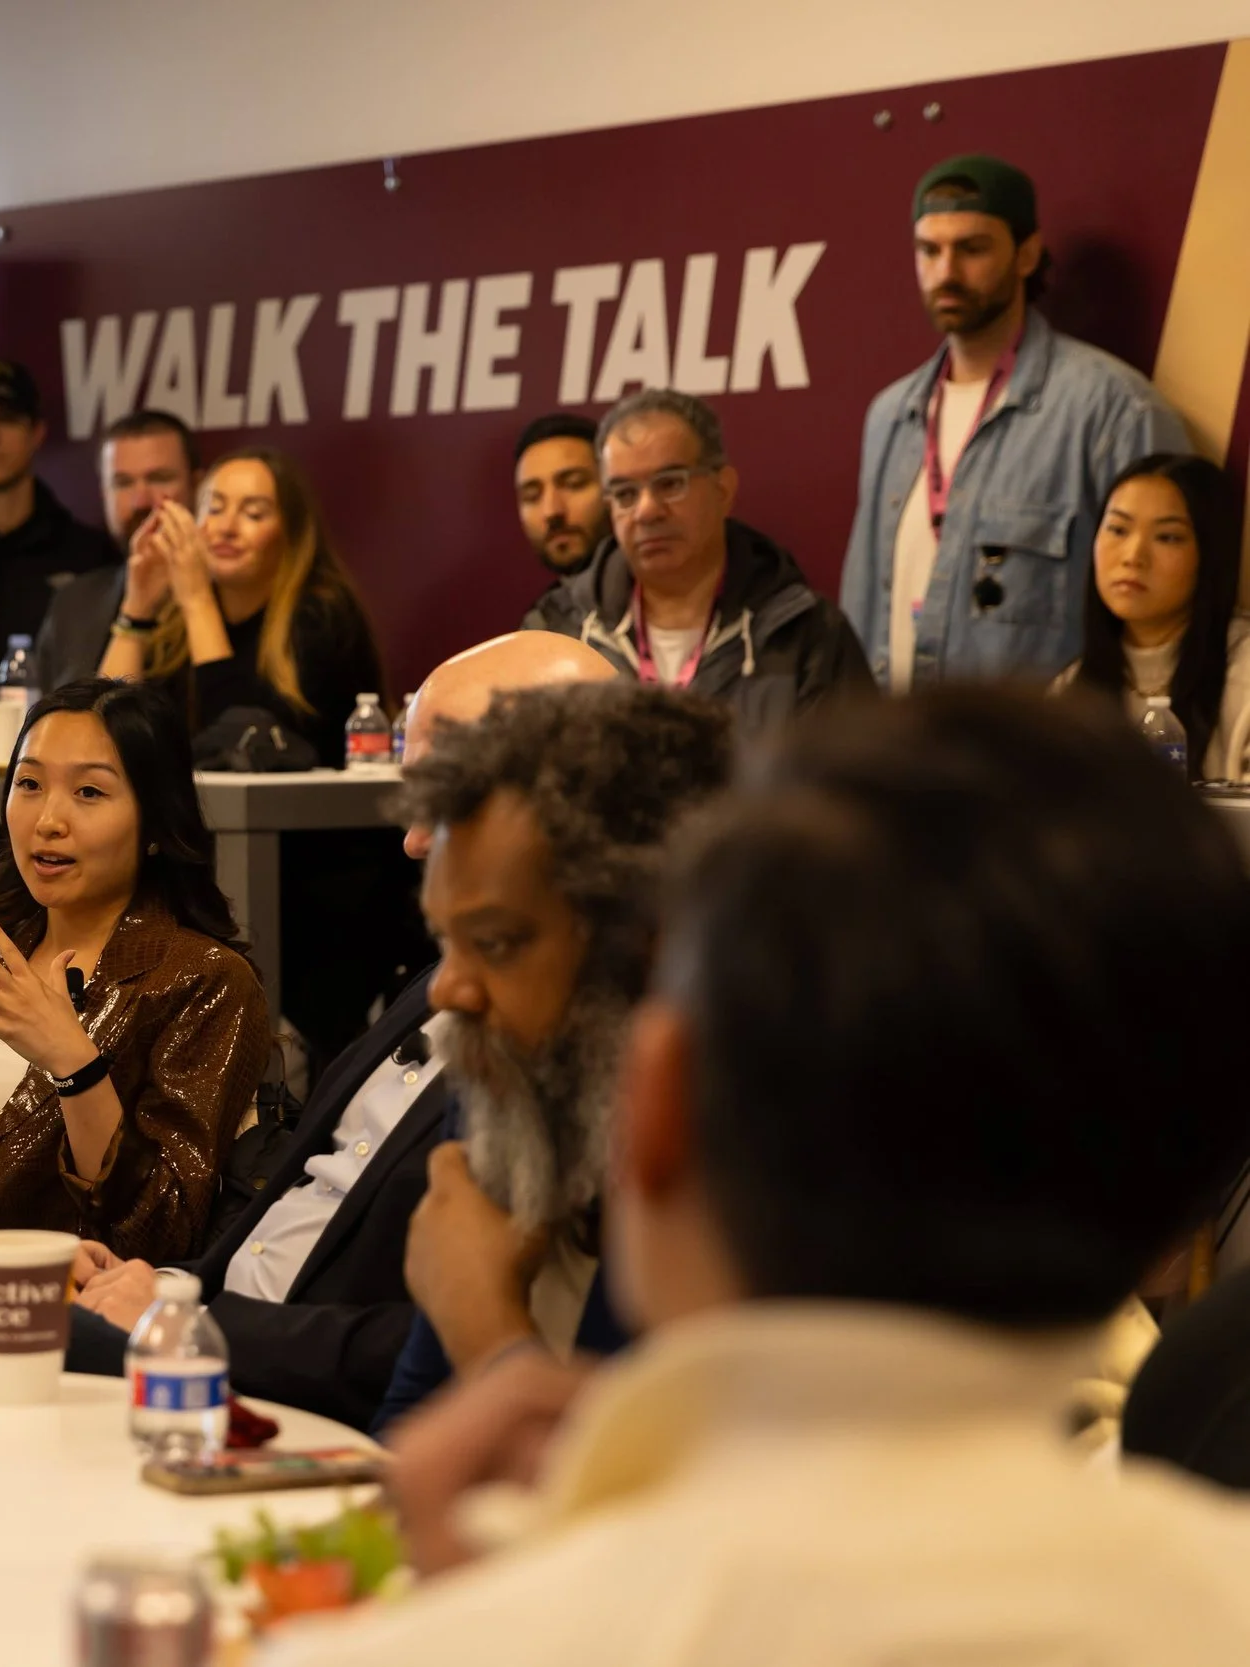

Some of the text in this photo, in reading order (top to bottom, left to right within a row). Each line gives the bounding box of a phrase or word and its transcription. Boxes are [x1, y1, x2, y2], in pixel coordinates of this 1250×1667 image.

[59, 241, 828, 441] WALK THE TALK
